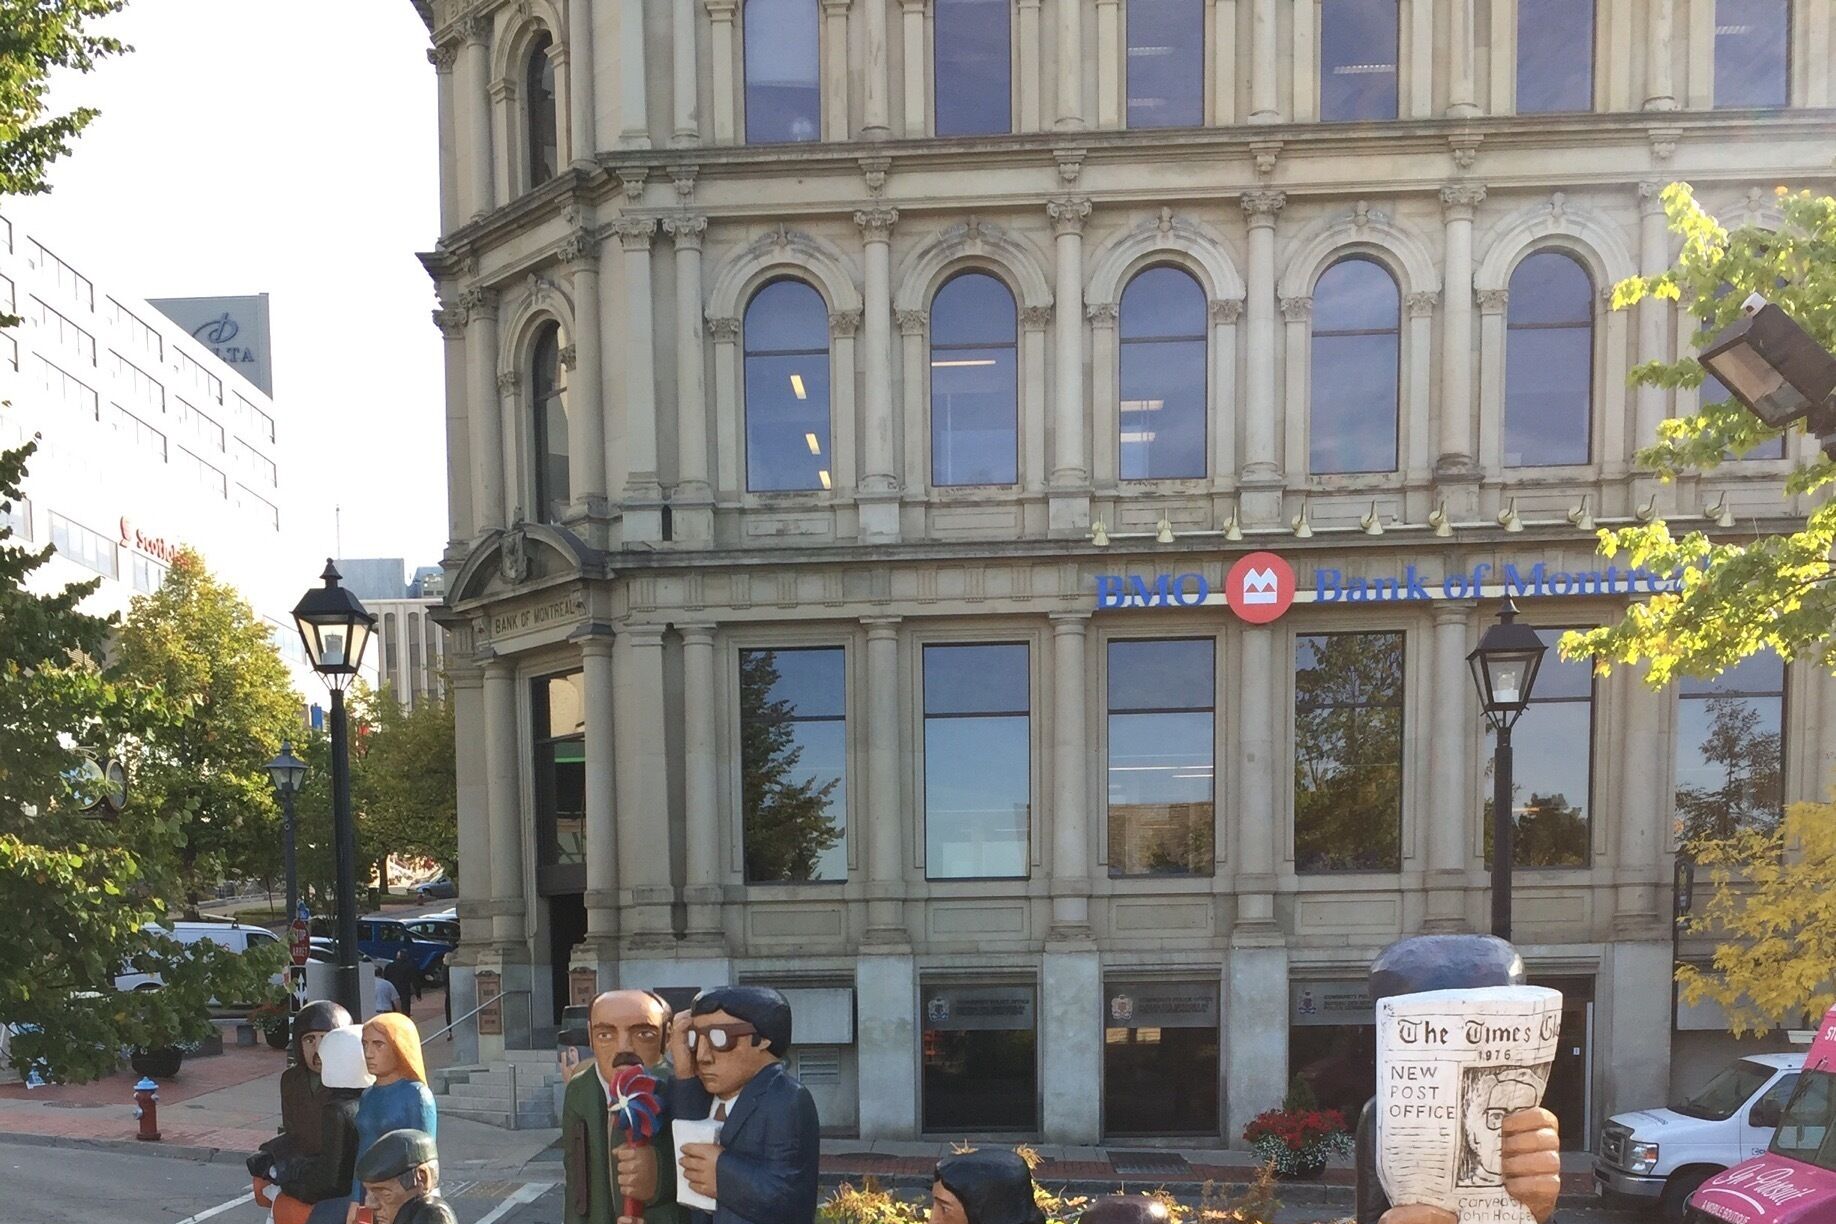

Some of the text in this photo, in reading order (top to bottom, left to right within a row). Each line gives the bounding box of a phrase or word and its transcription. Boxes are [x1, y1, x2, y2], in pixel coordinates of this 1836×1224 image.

[1094, 574, 1209, 609] BMO
[1313, 564, 1432, 604] Bank
[1443, 563, 1491, 600] of
[495, 600, 575, 634] BANK OF MONTREAL
[1397, 1018, 1449, 1044] The
[1465, 1019, 1532, 1045] Times
[1478, 1050, 1511, 1061] 1976
[1391, 1066, 1438, 1081] NEW
[1390, 1085, 1440, 1100] POST
[1389, 1104, 1455, 1119] OFFICE
[1743, 1168, 1816, 1206] Pursuit
[1458, 1209, 1489, 1222] John
[1705, 1201, 1726, 1217] MOBILE
